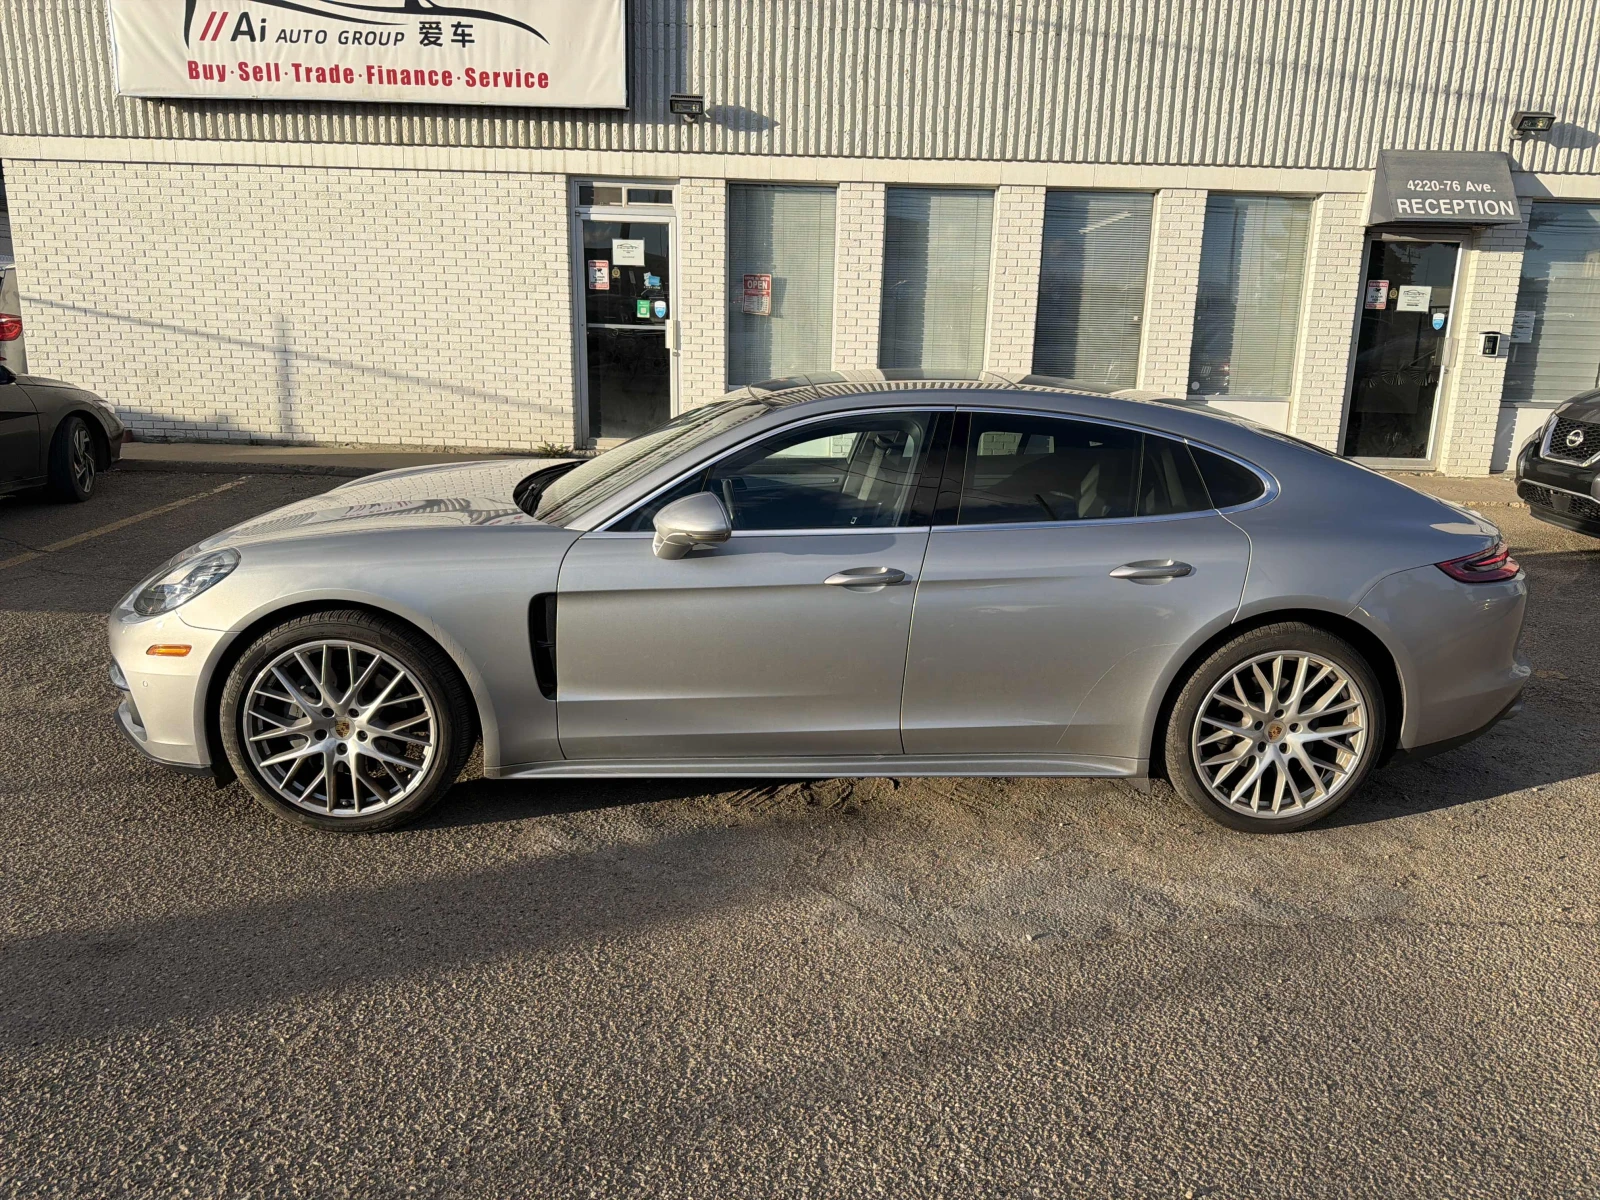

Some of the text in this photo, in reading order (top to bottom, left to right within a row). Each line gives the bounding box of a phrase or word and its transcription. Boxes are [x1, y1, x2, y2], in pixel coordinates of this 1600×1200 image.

[275, 29, 328, 45] AUTO
[337, 31, 405, 47] GROUP
[418, 21, 475, 48] 爱车
[187, 60, 549, 89] Buy Sell Trade Finance Service
[1407, 180, 1496, 193] 4220-76 Ave.
[1396, 198, 1515, 216] RECEPTION
[747, 280, 768, 290] OPEN
